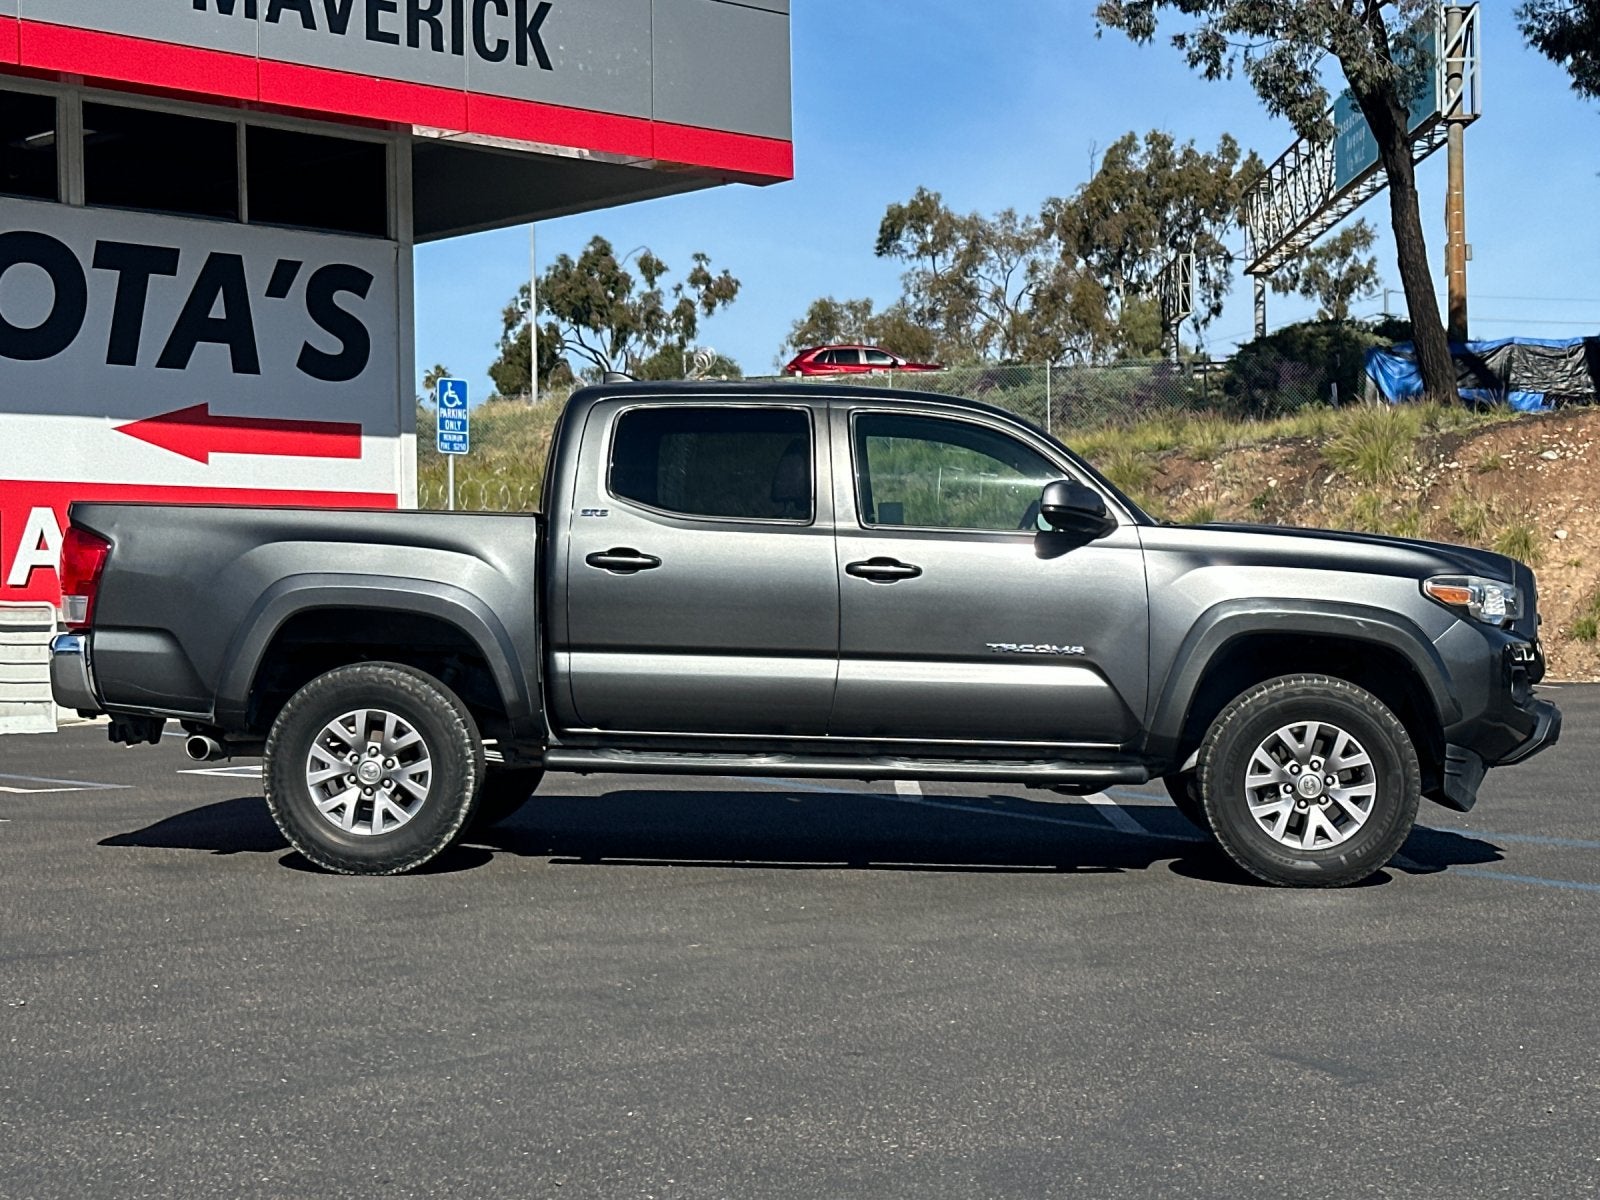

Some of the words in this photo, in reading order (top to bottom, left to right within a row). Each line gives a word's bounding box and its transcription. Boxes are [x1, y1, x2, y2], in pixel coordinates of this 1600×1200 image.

[192, 0, 554, 71] ERICK
[440, 407, 466, 420] PARKING
[445, 419, 462, 430] ONLY
